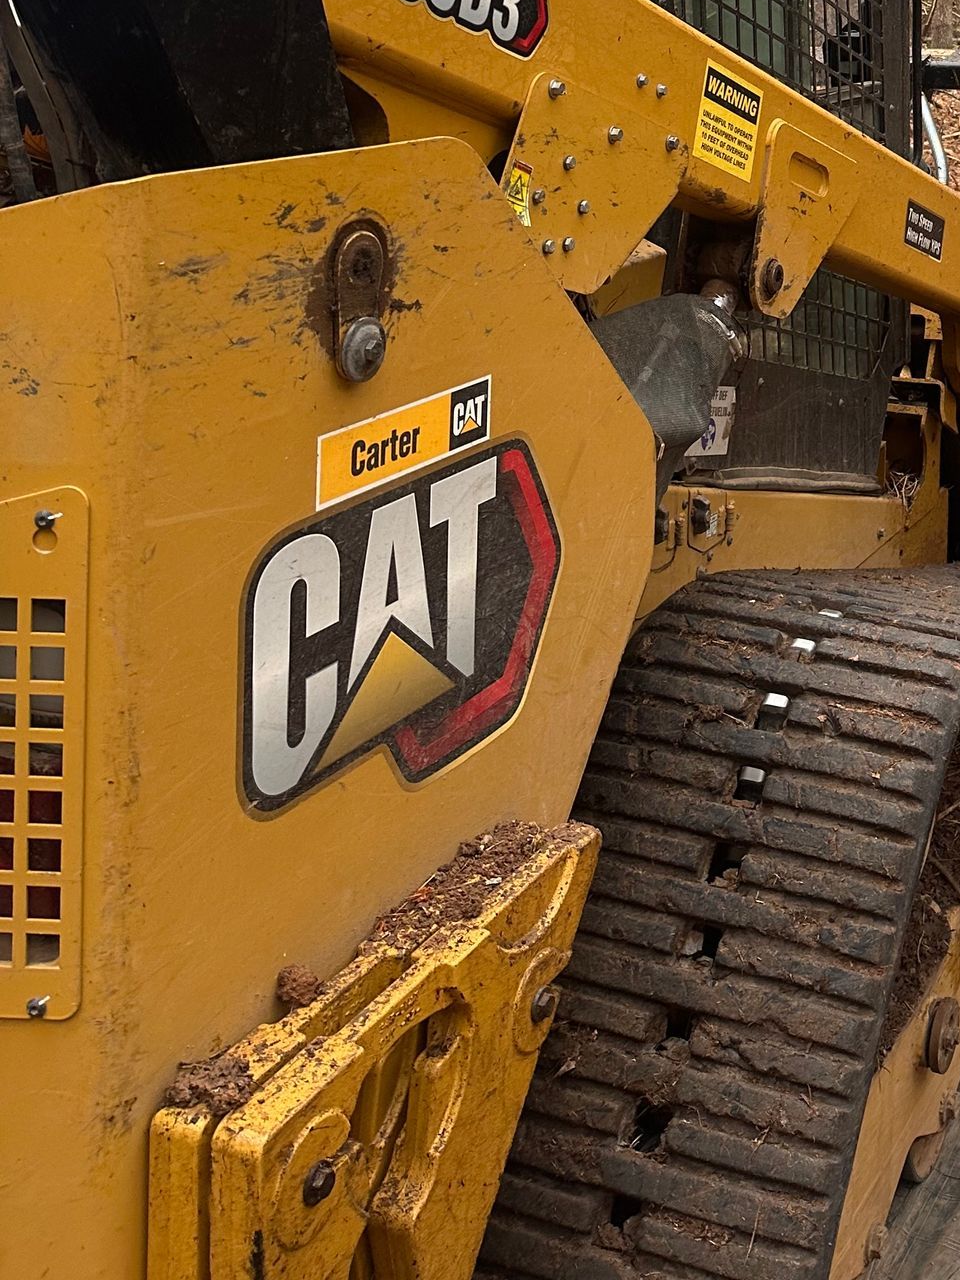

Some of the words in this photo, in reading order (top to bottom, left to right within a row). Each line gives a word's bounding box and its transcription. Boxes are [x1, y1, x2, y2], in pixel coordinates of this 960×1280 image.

[708, 75, 758, 117] WARNING
[701, 119, 711, 131] THIS
[711, 125, 738, 144] EQUIPMENT
[737, 138, 753, 152] WITHIN
[703, 109, 727, 128] UNLAWFUL
[728, 122, 735, 131] TO
[734, 126, 754, 142] OPERATE
[701, 131, 707, 140] 10
[707, 134, 720, 145] FEET
[720, 140, 727, 148] OF
[726, 144, 749, 161] OVERHEAD
[701, 142, 713, 154] HIGH
[714, 148, 734, 164] VOLTAGE
[733, 158, 746, 170] LINES
[719, 390, 728, 401] DEF
[351, 426, 421, 477] Carter
[452, 394, 486, 437] CAT
[251, 455, 498, 797] CAT
